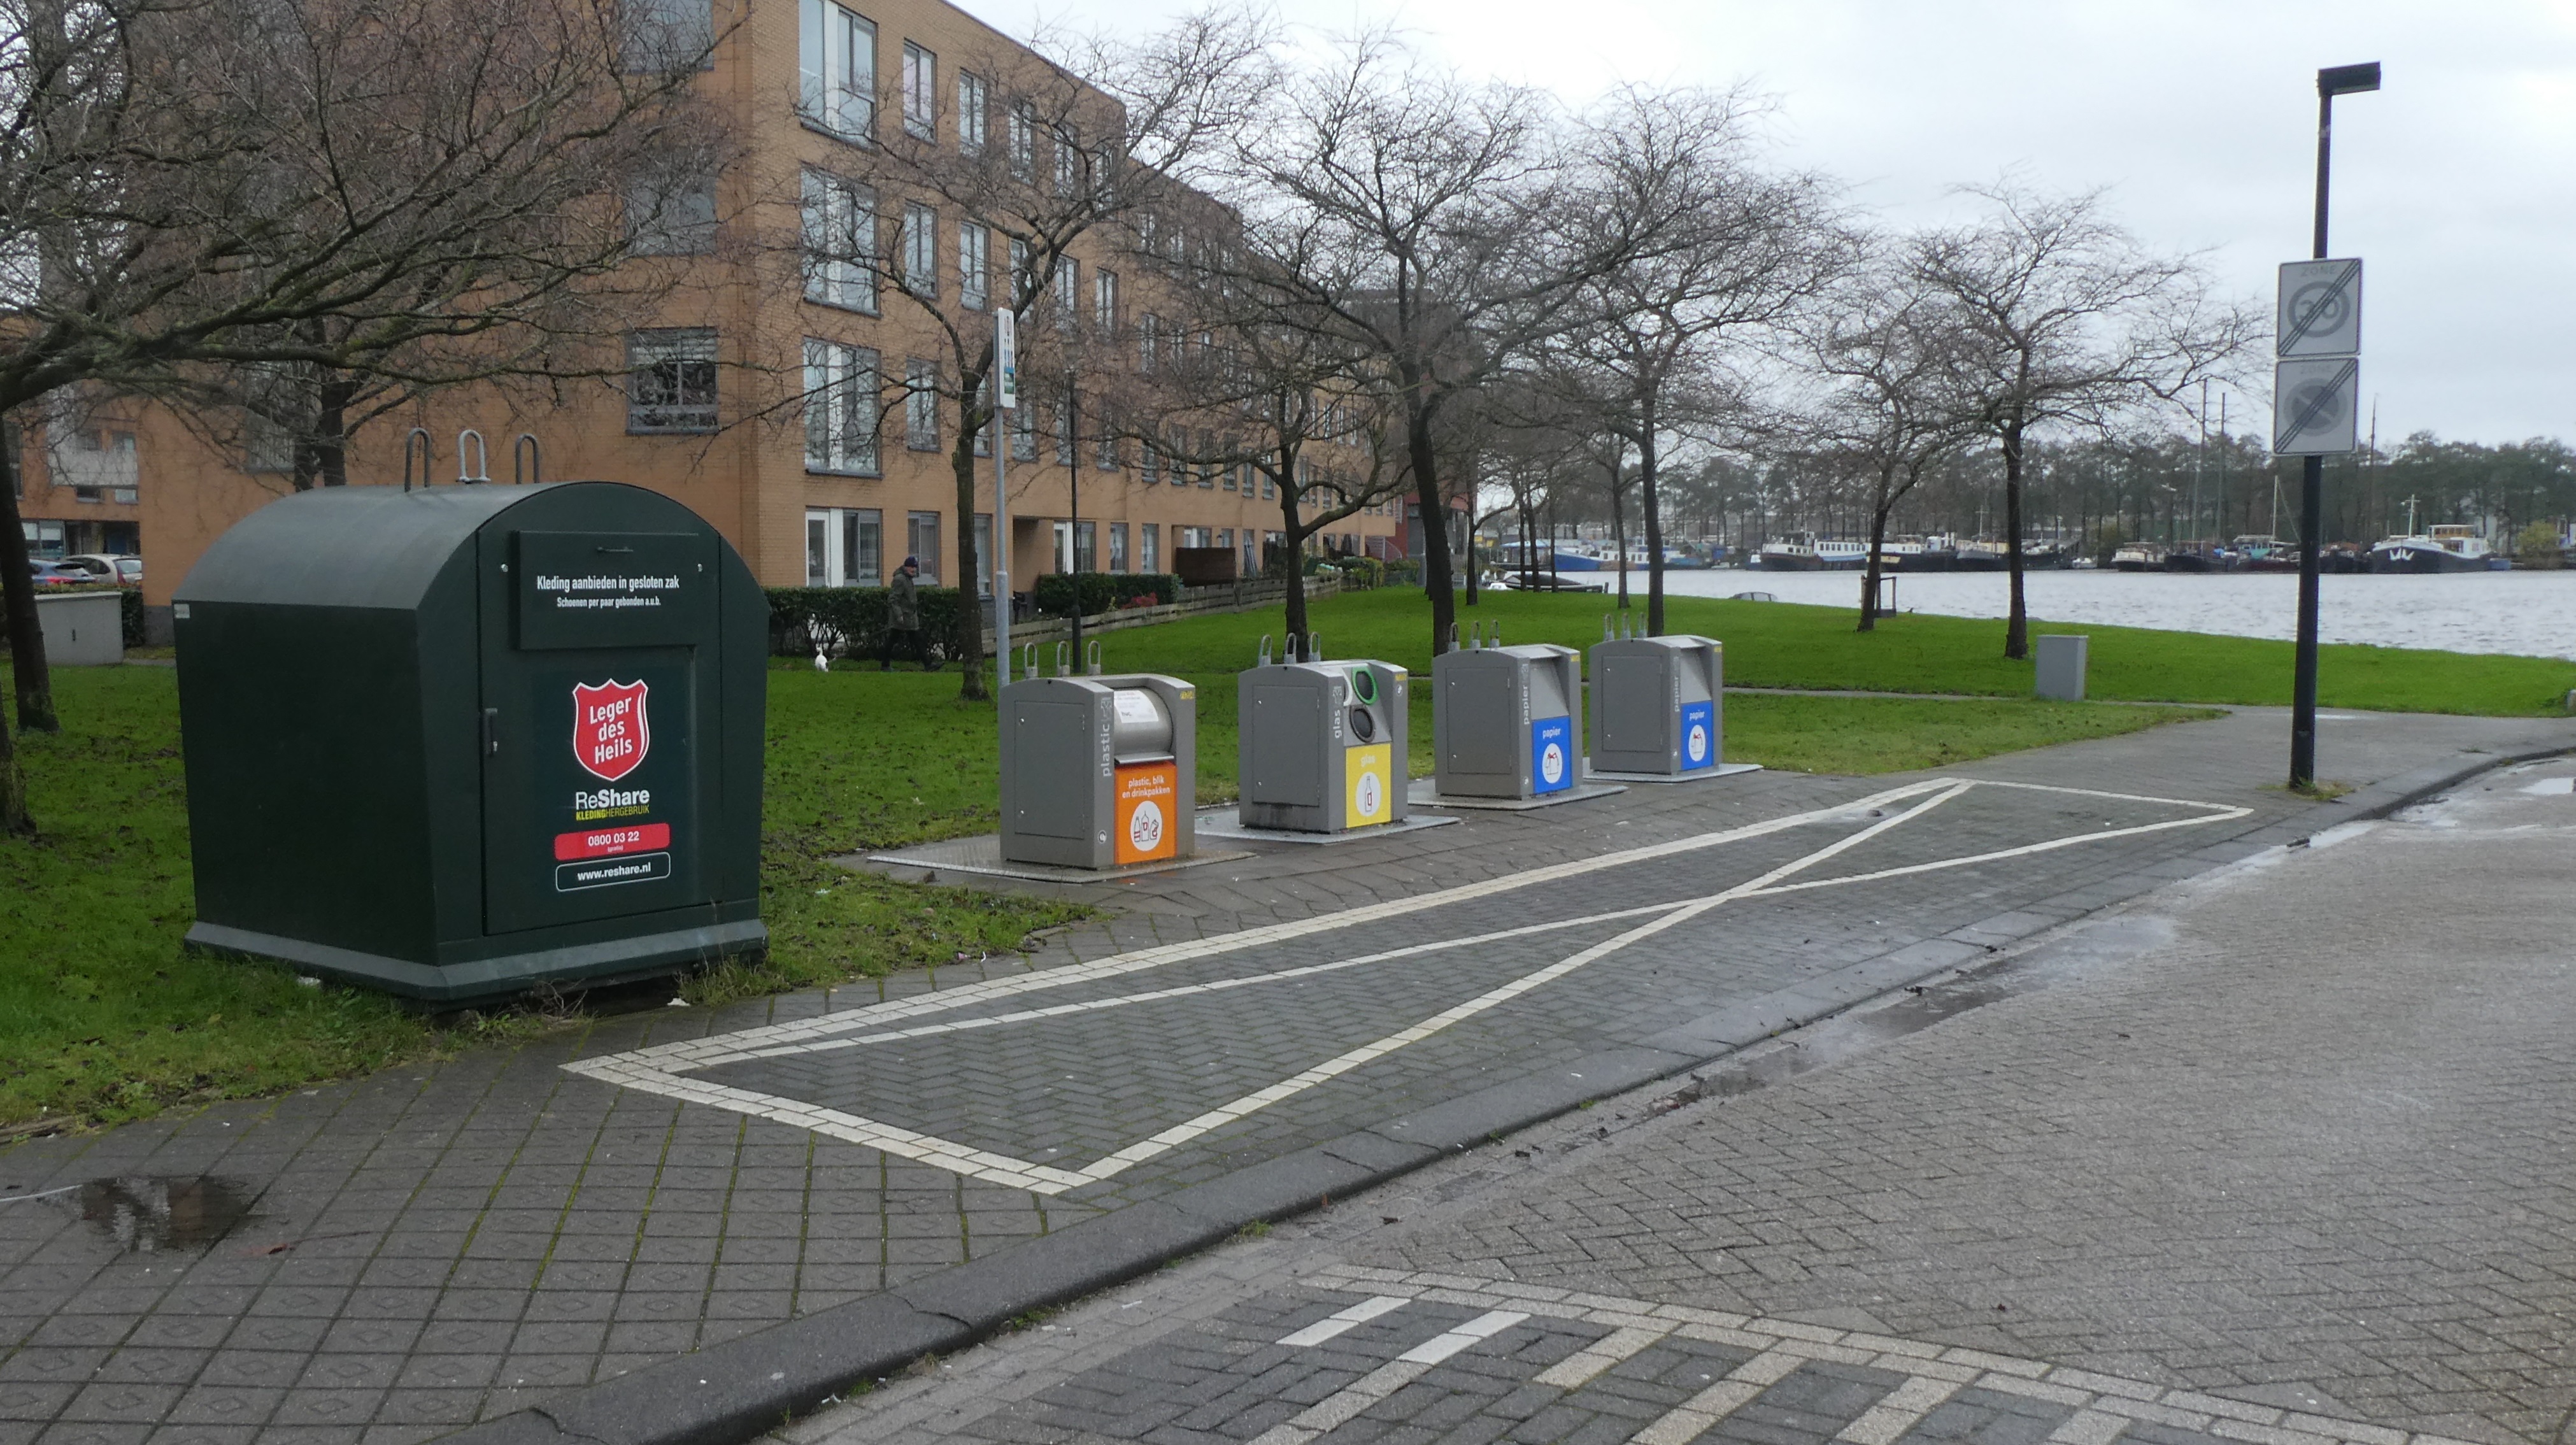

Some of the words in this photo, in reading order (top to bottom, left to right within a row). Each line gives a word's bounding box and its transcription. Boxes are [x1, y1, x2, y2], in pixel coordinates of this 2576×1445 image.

[2300, 264, 2337, 277] ZONE
[537, 576, 570, 593] Kleding
[573, 575, 617, 590] aanbieden
[619, 575, 627, 589] in
[629, 575, 664, 592] gesloten
[665, 574, 680, 588] zak
[557, 597, 587, 608] Schoenen
[588, 597, 599, 609] per
[600, 597, 614, 609] paar
[615, 596, 644, 609] gebonden
[644, 595, 661, 606] a.u.b.
[590, 697, 632, 725] Leger
[1522, 685, 1530, 725] papier
[1333, 709, 1342, 739] glas
[1689, 709, 1705, 722] papier
[599, 720, 625, 742] des
[1542, 727, 1561, 739] papier
[595, 737, 633, 764] Heils
[1100, 723, 1112, 777] plastic
[1360, 753, 1376, 768] glas
[1128, 778, 1151, 789] plastic,
[1153, 774, 1164, 785] blik
[575, 788, 650, 810] ReShare
[1122, 790, 1130, 799] en
[1131, 786, 1170, 797] drinkpakken
[576, 804, 650, 821] KLEDINGHERGEBRUIK
[588, 834, 611, 847] 0800
[613, 832, 625, 844] 03
[627, 830, 639, 843] 22
[577, 862, 651, 881] www.reshare.nl
